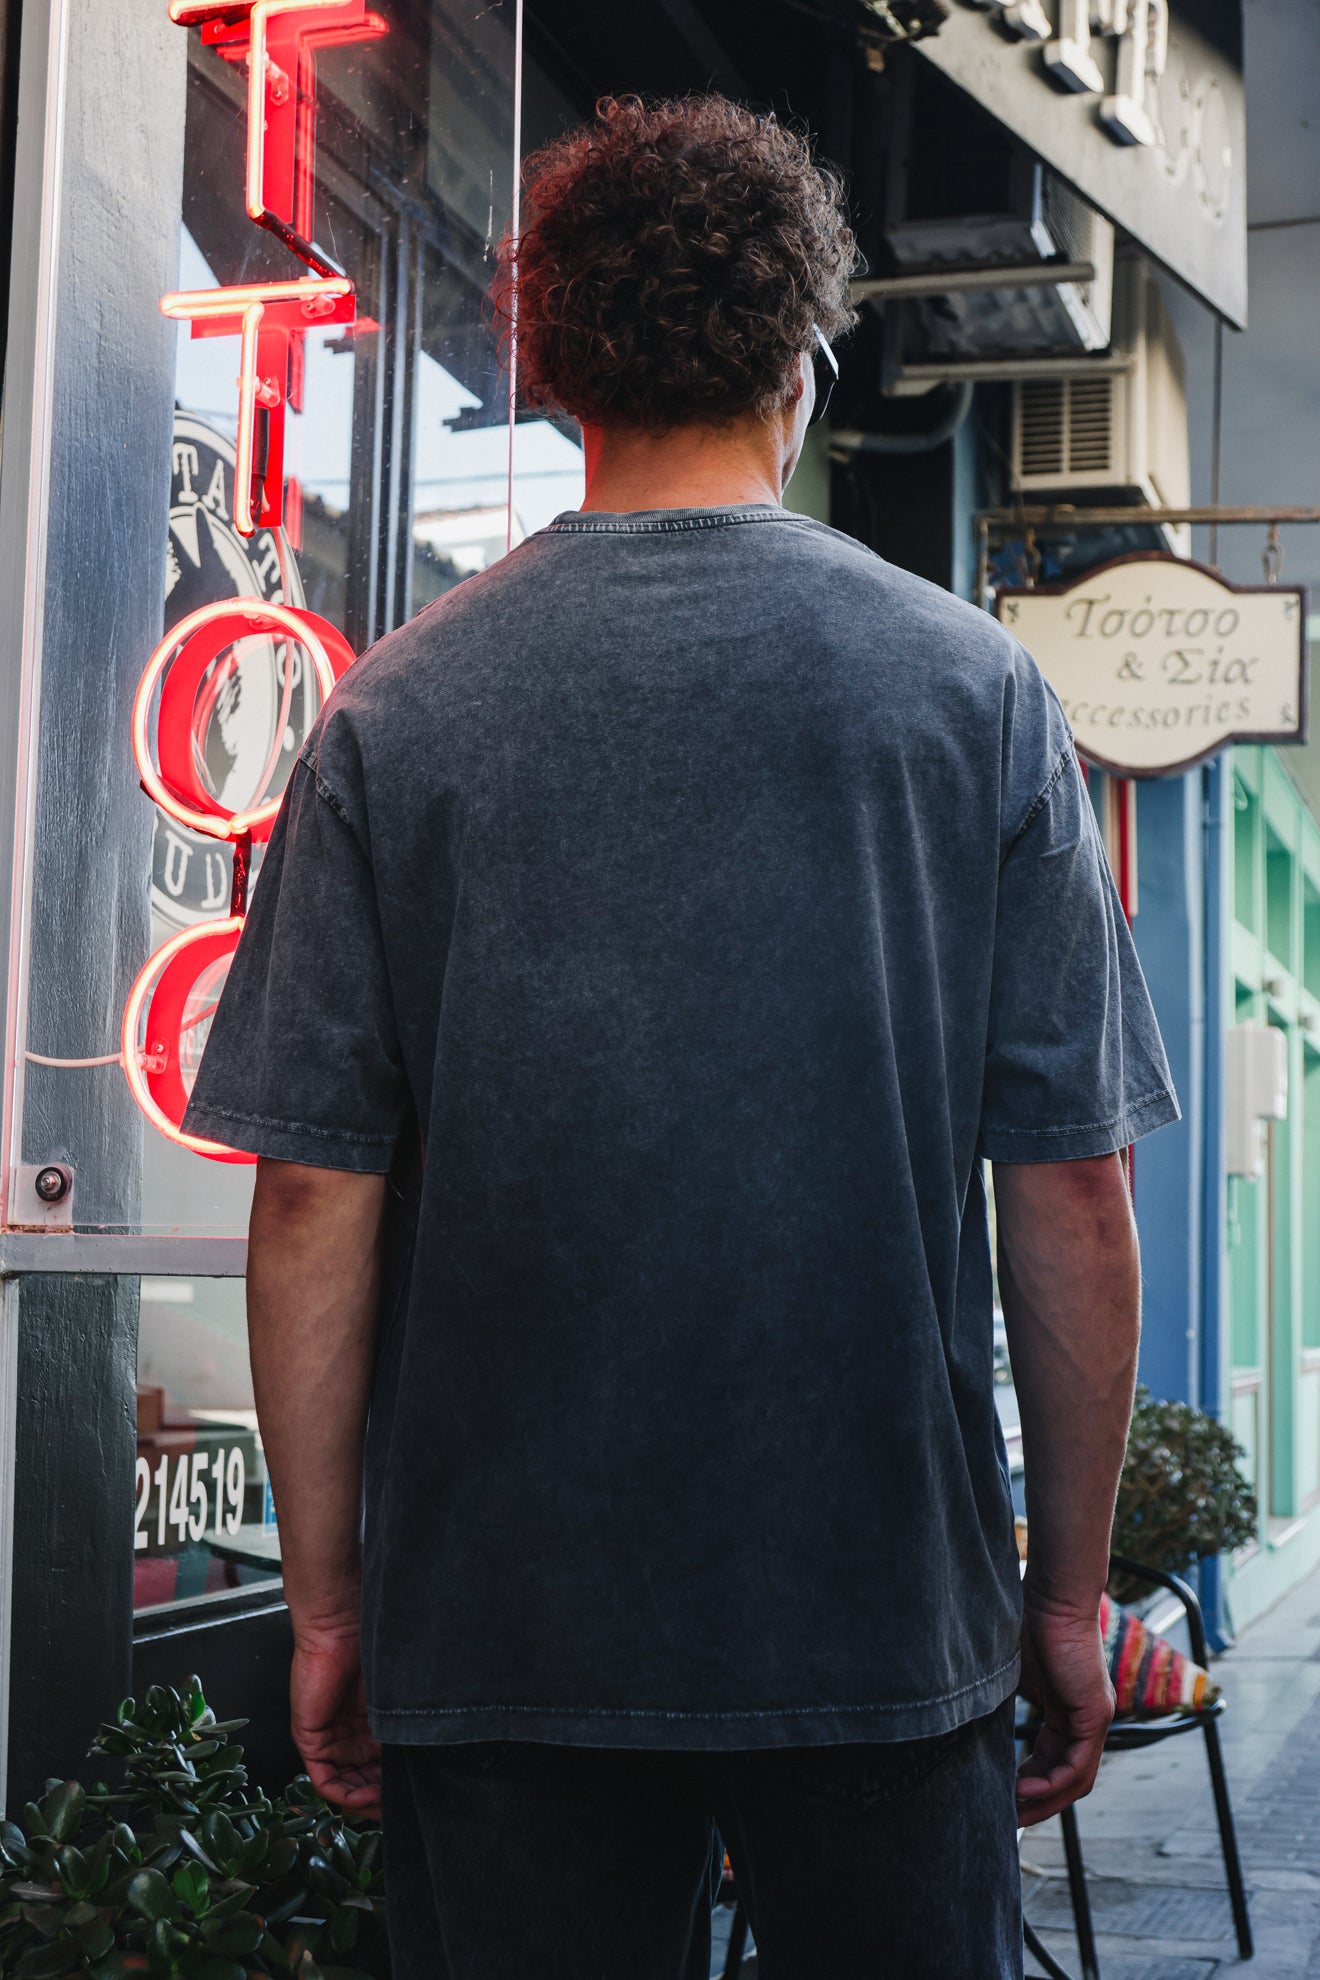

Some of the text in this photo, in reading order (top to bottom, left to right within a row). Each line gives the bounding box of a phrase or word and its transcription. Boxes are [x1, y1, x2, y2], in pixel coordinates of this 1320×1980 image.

[1116, 651, 1145, 682] &
[1062, 694, 1251, 728] ccessories
[134, 1446, 246, 1549] 214519
